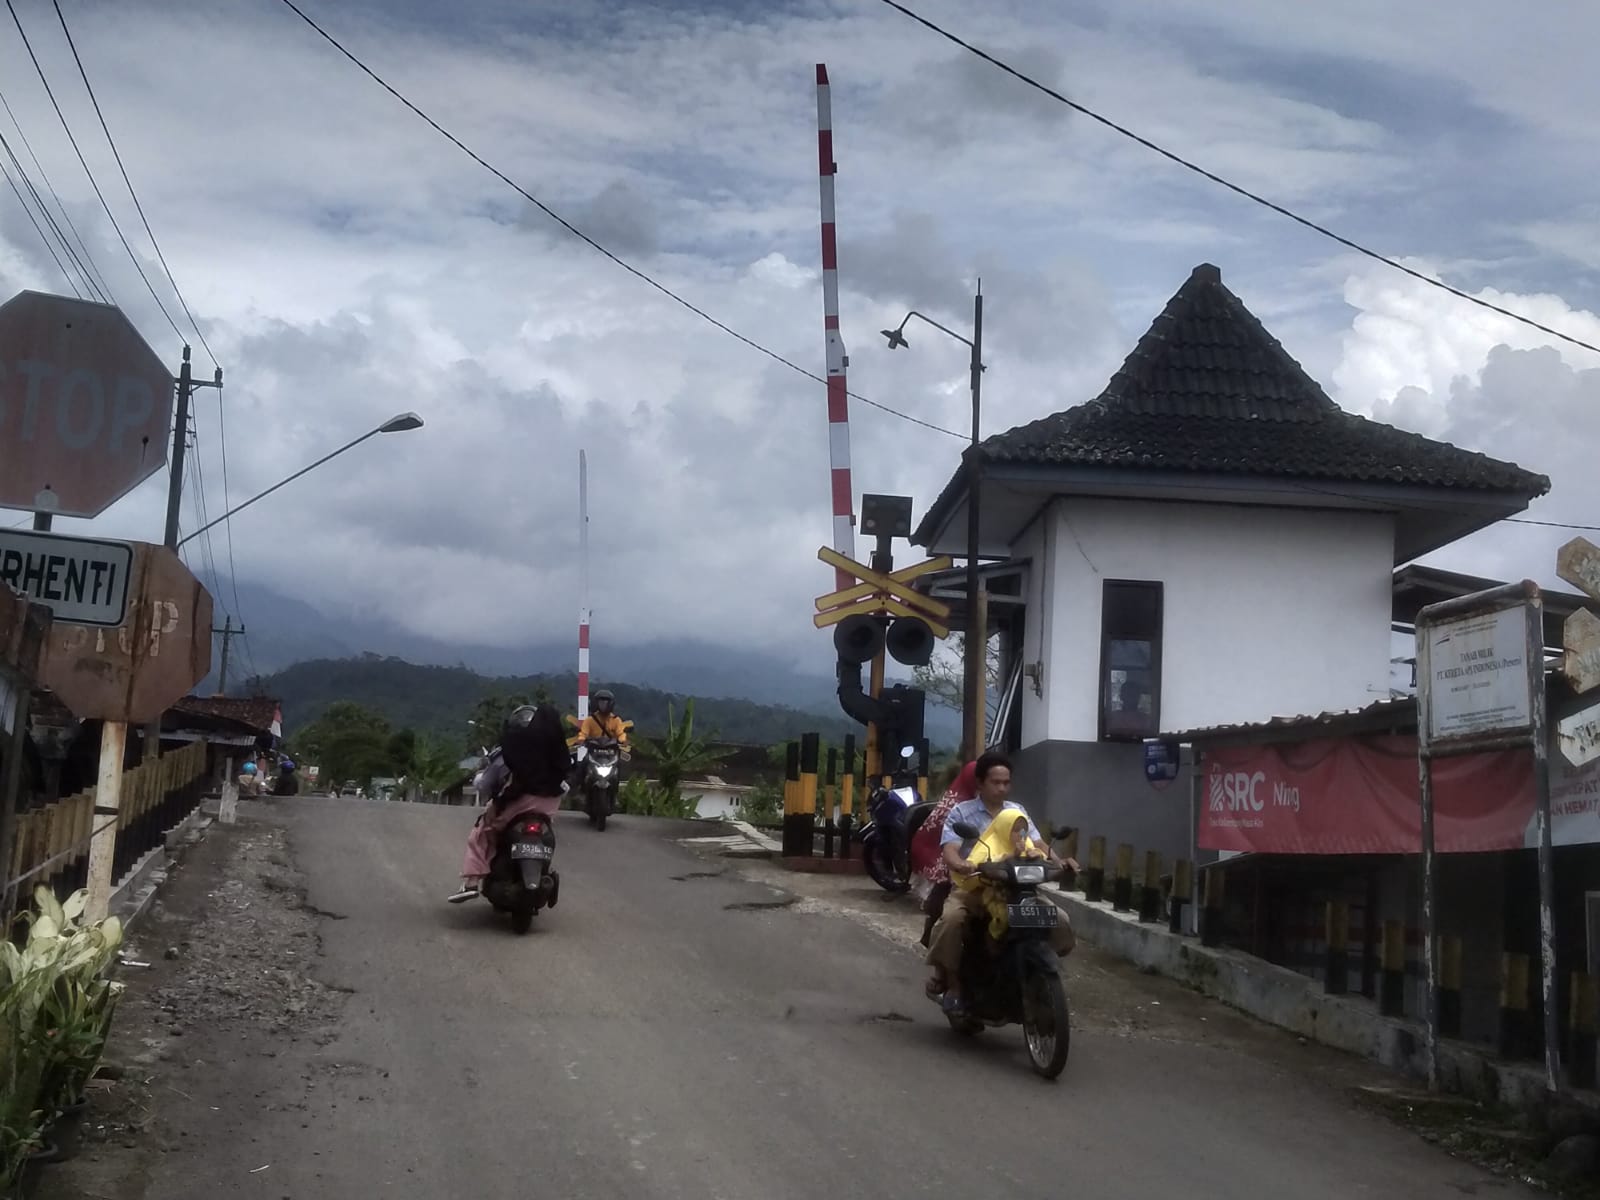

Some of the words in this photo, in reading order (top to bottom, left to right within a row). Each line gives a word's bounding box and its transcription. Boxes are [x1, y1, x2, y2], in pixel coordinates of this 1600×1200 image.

[0, 358, 156, 453] TOP
[0, 550, 116, 606] RHENTI
[1224, 771, 1265, 811] SRC
